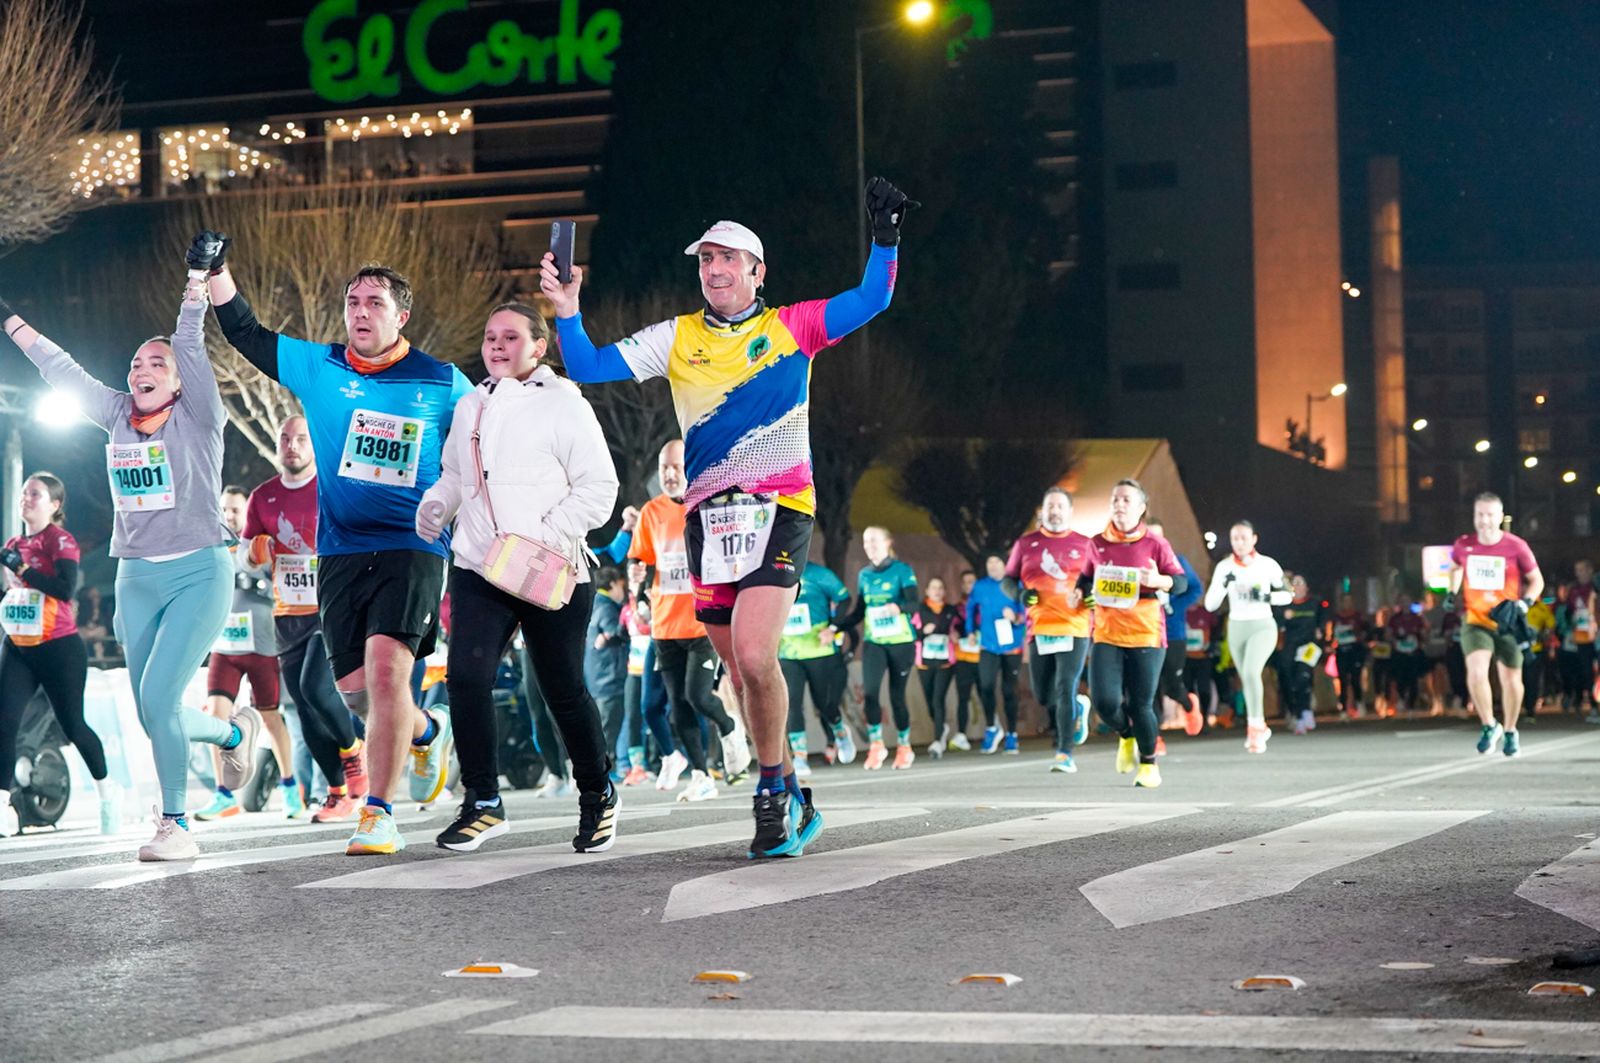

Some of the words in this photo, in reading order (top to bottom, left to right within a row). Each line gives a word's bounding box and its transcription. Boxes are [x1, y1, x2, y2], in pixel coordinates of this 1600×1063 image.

[303, 0, 399, 103] El
[405, 0, 623, 94] Corte
[387, 422, 396, 430] DE
[355, 434, 411, 463] 13981
[116, 466, 163, 488] 14001
[721, 532, 757, 556] 1176
[284, 573, 314, 587] 4541
[1102, 580, 1131, 594] 2056
[5, 605, 36, 620] 13165
